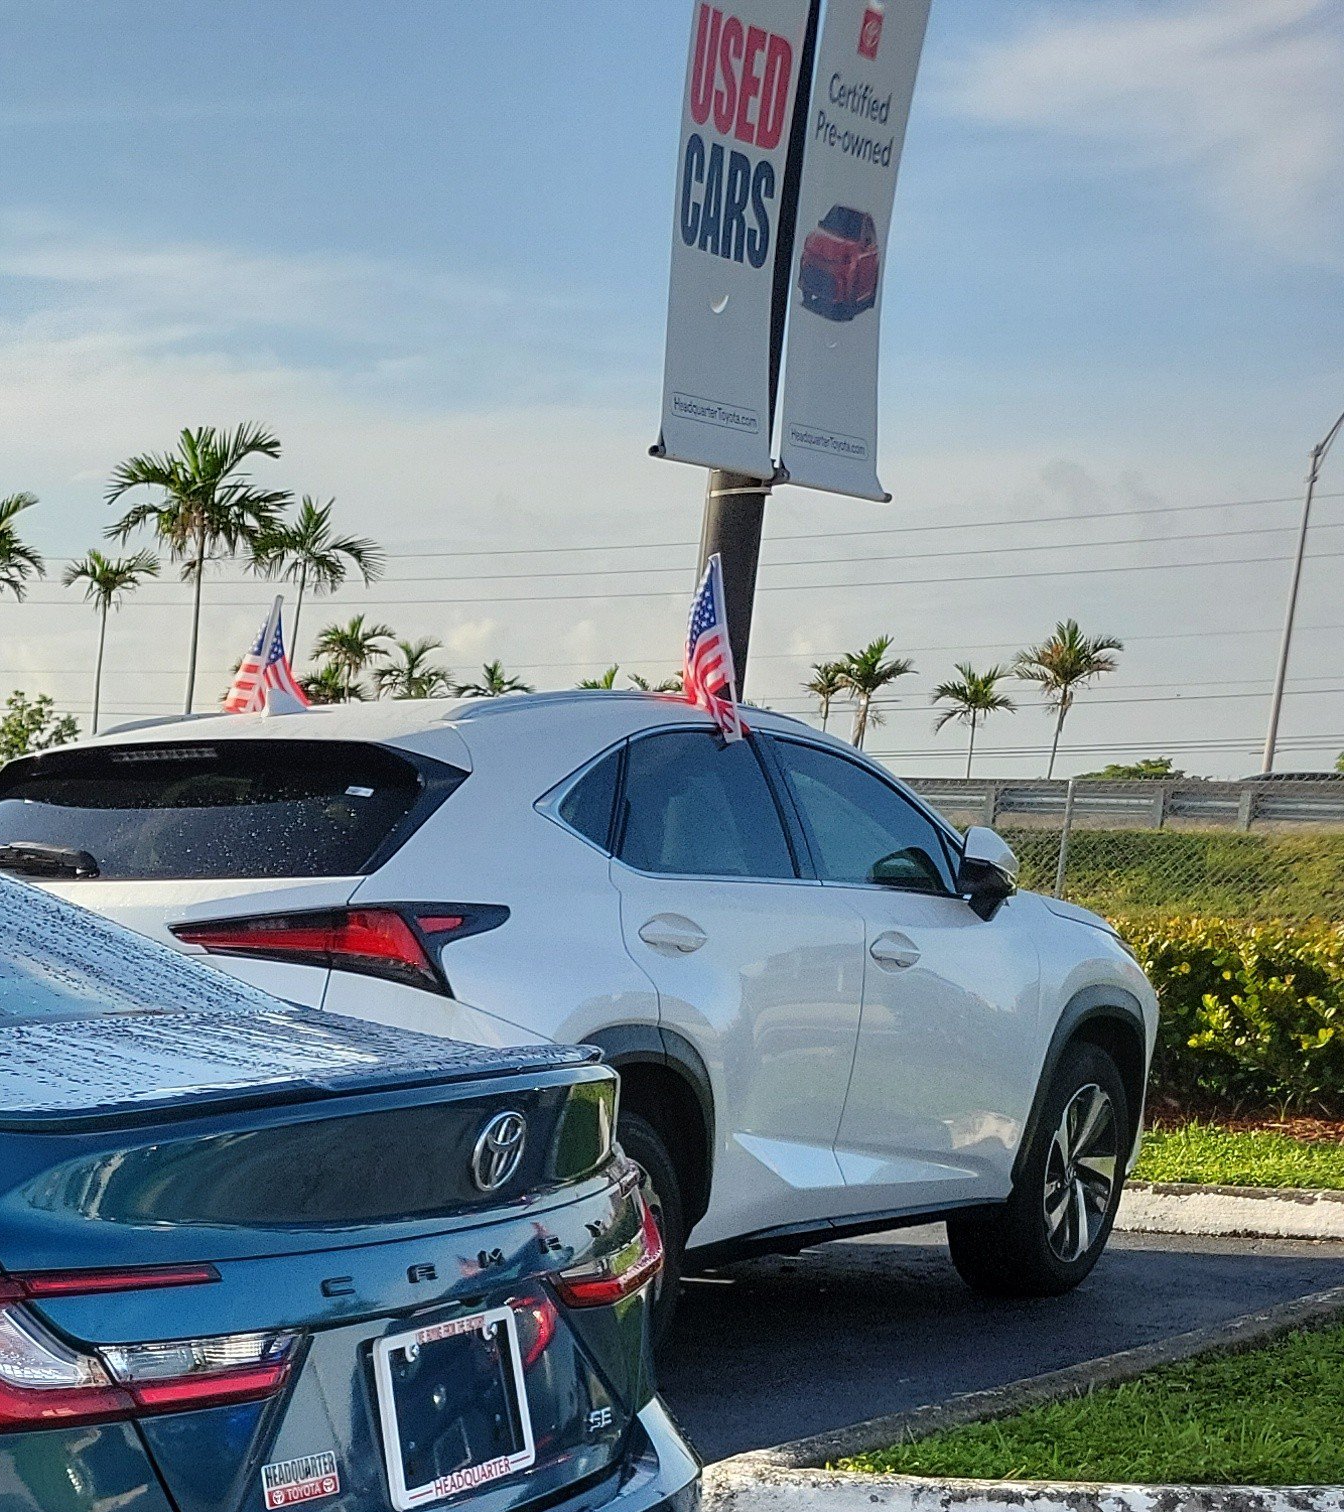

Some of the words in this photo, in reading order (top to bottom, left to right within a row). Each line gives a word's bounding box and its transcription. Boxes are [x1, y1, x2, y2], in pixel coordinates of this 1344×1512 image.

[691, 3, 793, 150] USED
[829, 72, 893, 125] Certified
[815, 110, 893, 168] Pre-owned
[680, 132, 775, 270] CARS
[264, 1452, 336, 1489] HEADQUARTER
[286, 1482, 322, 1501] TOYOTA
[433, 1457, 511, 1497] HEADQUARTER
